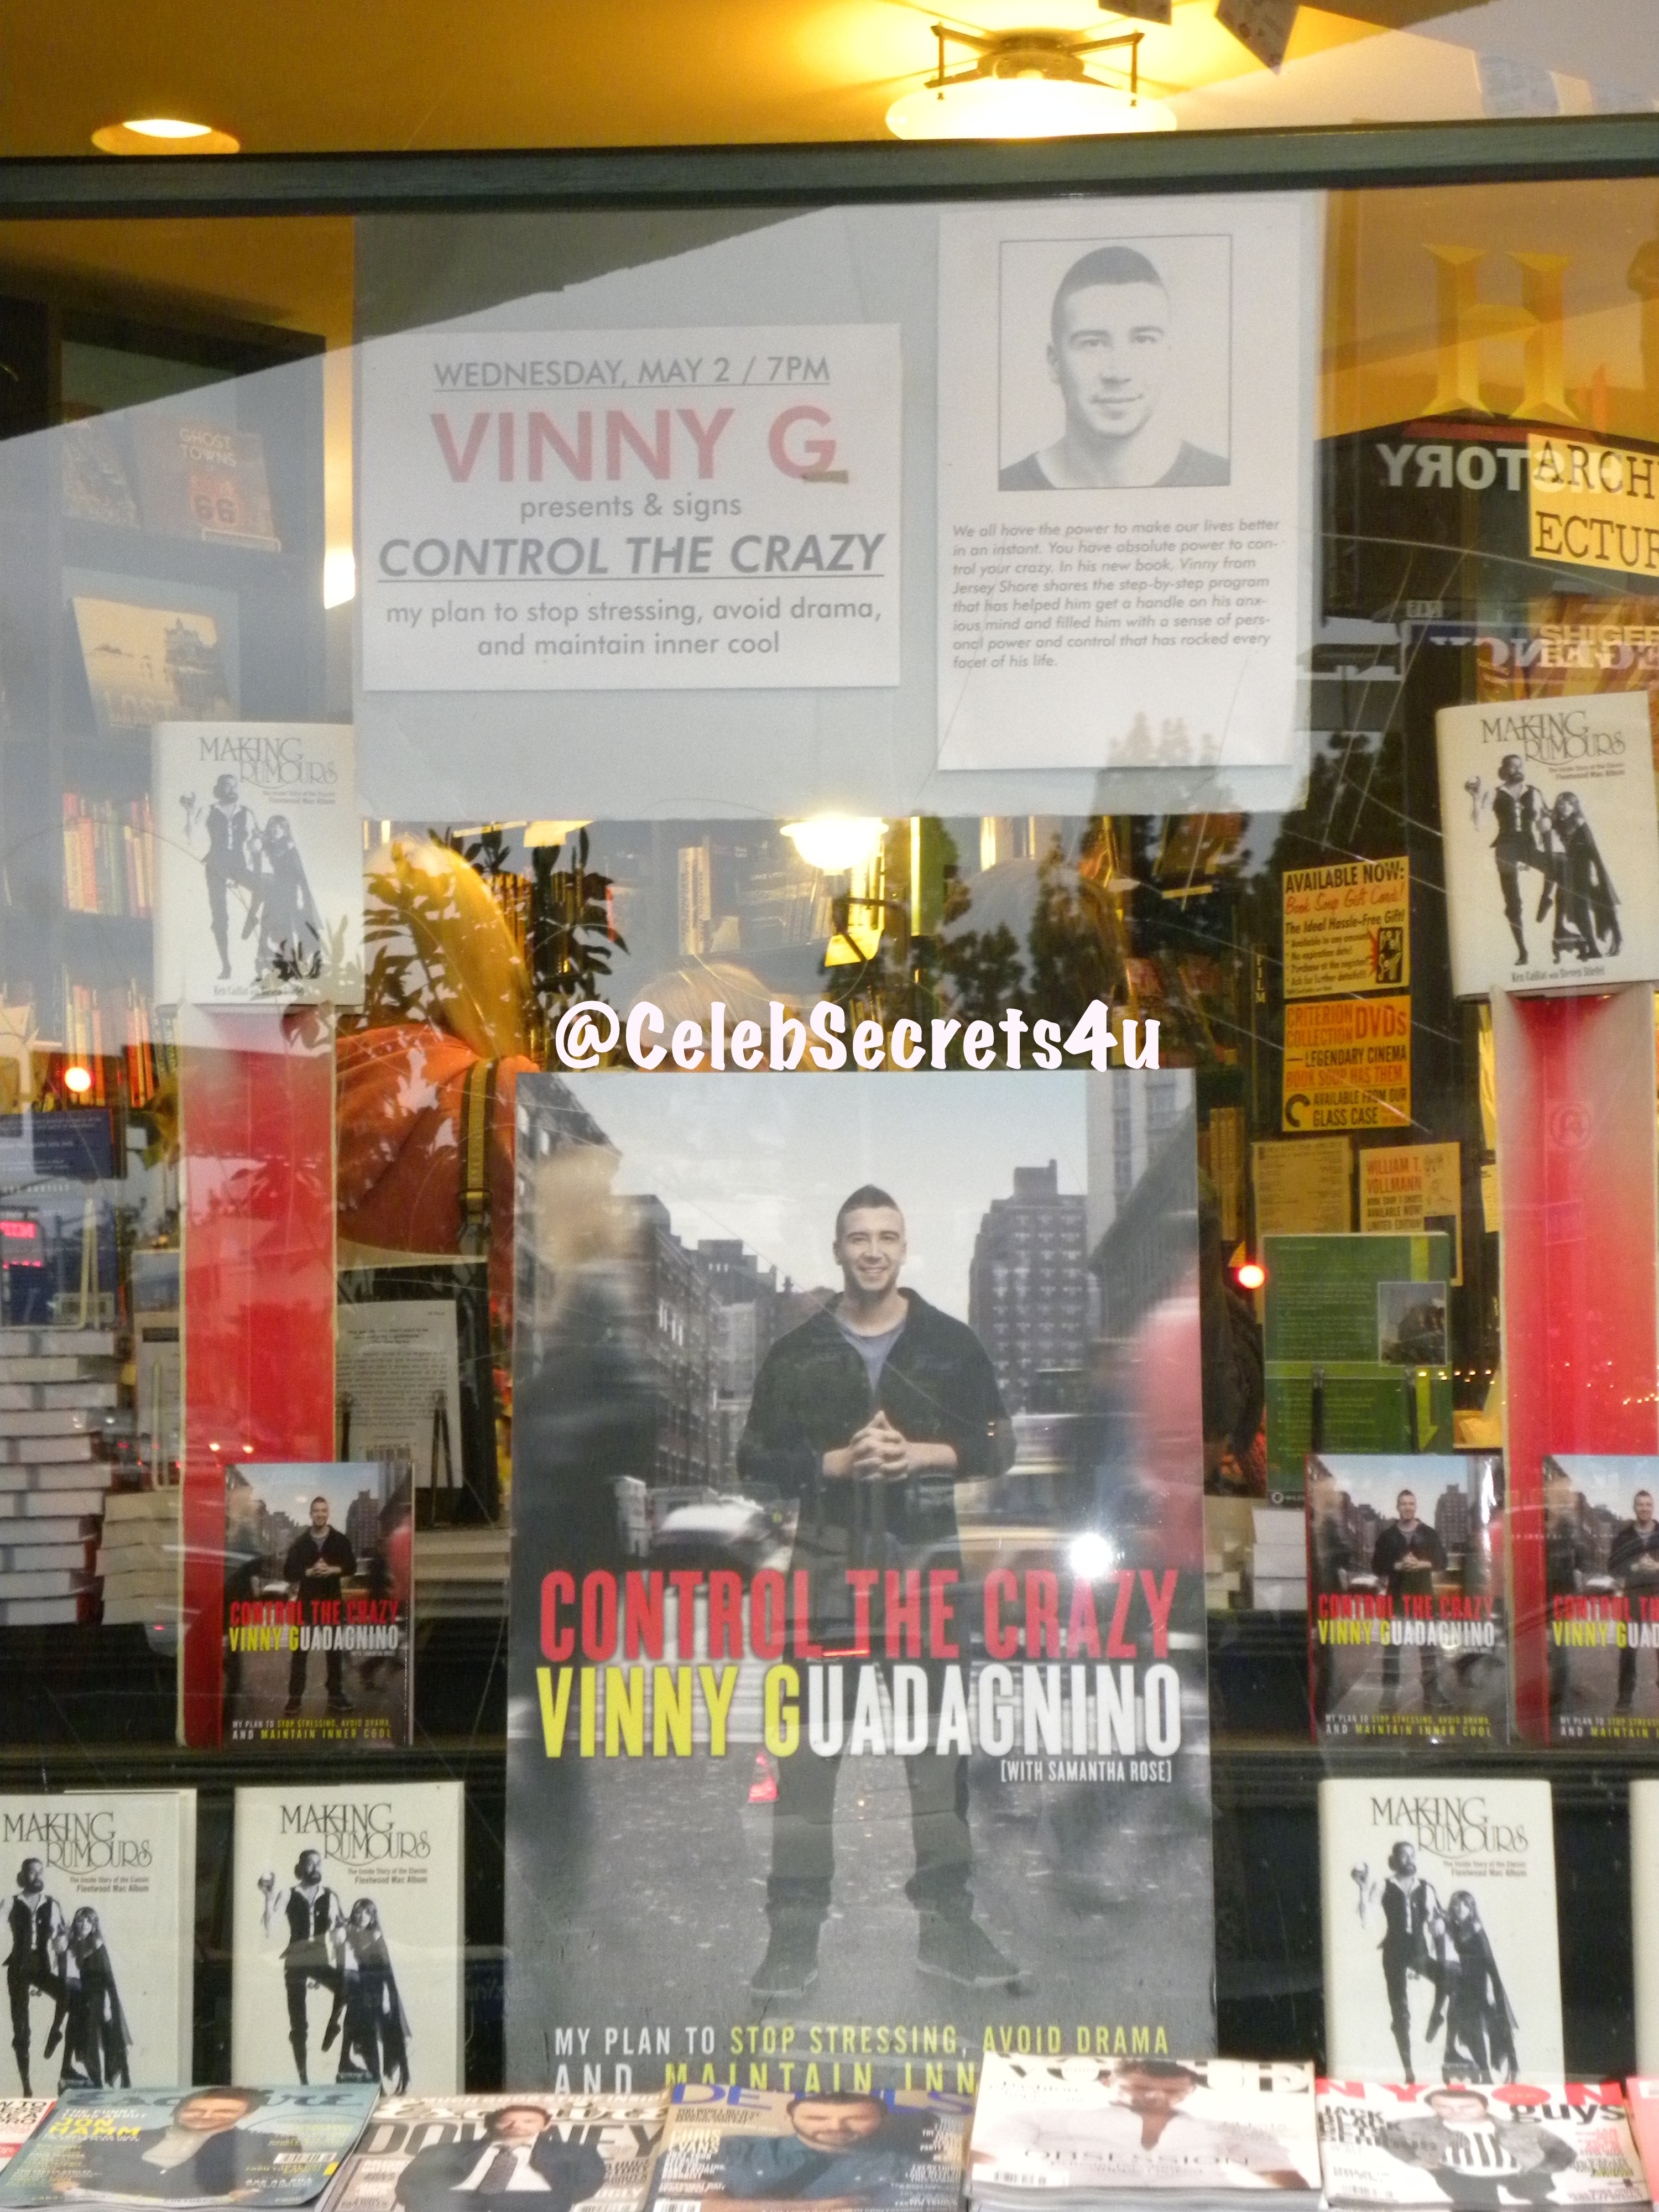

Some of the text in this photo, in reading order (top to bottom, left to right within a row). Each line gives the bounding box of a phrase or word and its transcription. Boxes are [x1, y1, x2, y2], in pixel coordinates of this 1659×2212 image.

[434, 359, 625, 389] WEDNESDAY,
[638, 358, 702, 384] MAY
[714, 357, 730, 383] 2
[768, 356, 830, 382] 7PM
[430, 405, 837, 482] VINNY G
[1533, 440, 1659, 500] ARCH
[520, 492, 742, 524] presents & signs
[952, 518, 1280, 539] We all have the power to make our lives better
[378, 533, 886, 577] CONTROL THE CRAZY
[952, 538, 1278, 556] in an instant. You have absolute power to con-
[952, 555, 1256, 578] trol your crazy. In his new book, Vinny from
[952, 576, 1270, 597] Jersey Shore shares the step-by-step program
[387, 597, 882, 628] my plan to stop stressing, avoid drama,
[952, 594, 1267, 614] that has helped him get a handle on his anx-
[952, 612, 1270, 631] ious mind and filled him with a sense of pers-
[478, 631, 780, 656] and maintain inner cool
[952, 631, 1271, 653] onal power and control that has rocked every
[952, 653, 1058, 669] facet of his life.
[1480, 710, 1588, 744] MAKING
[199, 737, 304, 762] MAKING
[1526, 731, 1626, 765] RUMOURS
[239, 759, 339, 789] RUMOURS
[1286, 860, 1404, 894] AVAILABLE NOW:
[1287, 1004, 1407, 1039] CRITERION DVDs
[1287, 1027, 1353, 1048] COLLECTION
[1306, 1045, 1406, 1067] LEGENDARY CINEMA
[1314, 1091, 1359, 1106] AVAILABLE
[1313, 1107, 1379, 1127] GLASS CASE
[231, 1600, 399, 1626] CONTROL THE CRAZY
[541, 1568, 1178, 1662] CONTROL THE CRAZY
[1318, 1594, 1494, 1621] CONTROL THE CRAZY
[1553, 1595, 1632, 1621] CONTROL
[229, 1625, 399, 1651] VINNY GUADAGNINO
[1318, 1620, 1494, 1647] VINNY GUADAGNINO
[1552, 1621, 1608, 1647] VINNY
[536, 1665, 1181, 1757] VINNY GUADAGNINO
[1001, 1760, 1172, 1783] [WITH SAMANTHA ROSE]
[280, 1803, 395, 1834] MAKING
[1371, 1796, 1490, 1825] MAKING
[3, 1812, 116, 1842] MAKING
[324, 1830, 430, 1866] RUMOURS
[1417, 1825, 1528, 1859] RUMOURS
[46, 1840, 152, 1875] RUMOURS
[555, 2026, 1169, 2057] MY PLAN TO STOP STRESSING, AVOID DRAMA
[555, 2064, 634, 2095] AND
[665, 2063, 873, 2093] MAINTAIN
[1509, 2103, 1626, 2125] guys
